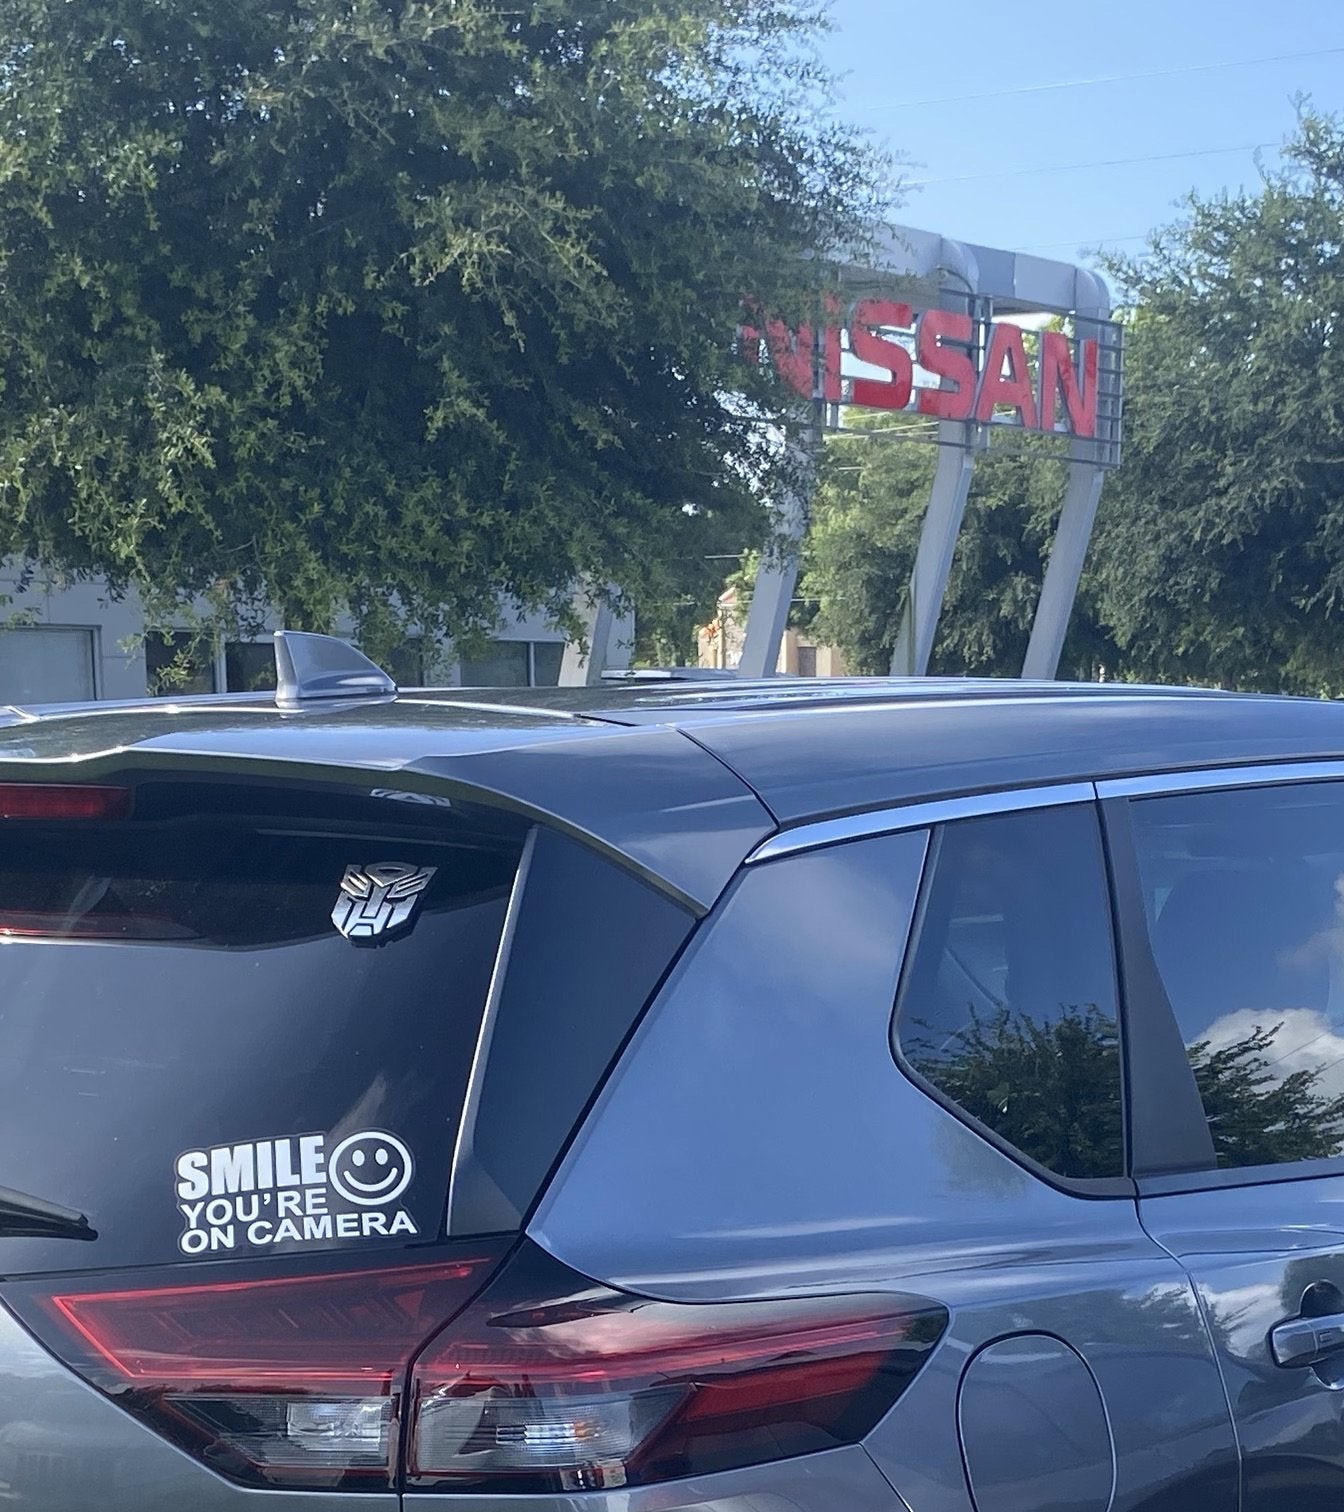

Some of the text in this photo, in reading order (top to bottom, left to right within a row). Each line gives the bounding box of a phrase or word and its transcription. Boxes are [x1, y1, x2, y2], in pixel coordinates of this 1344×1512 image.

[177, 1135, 327, 1200] SMILE
[180, 1187, 329, 1229] YOU'RE
[181, 1210, 418, 1254] ON CAMERA
